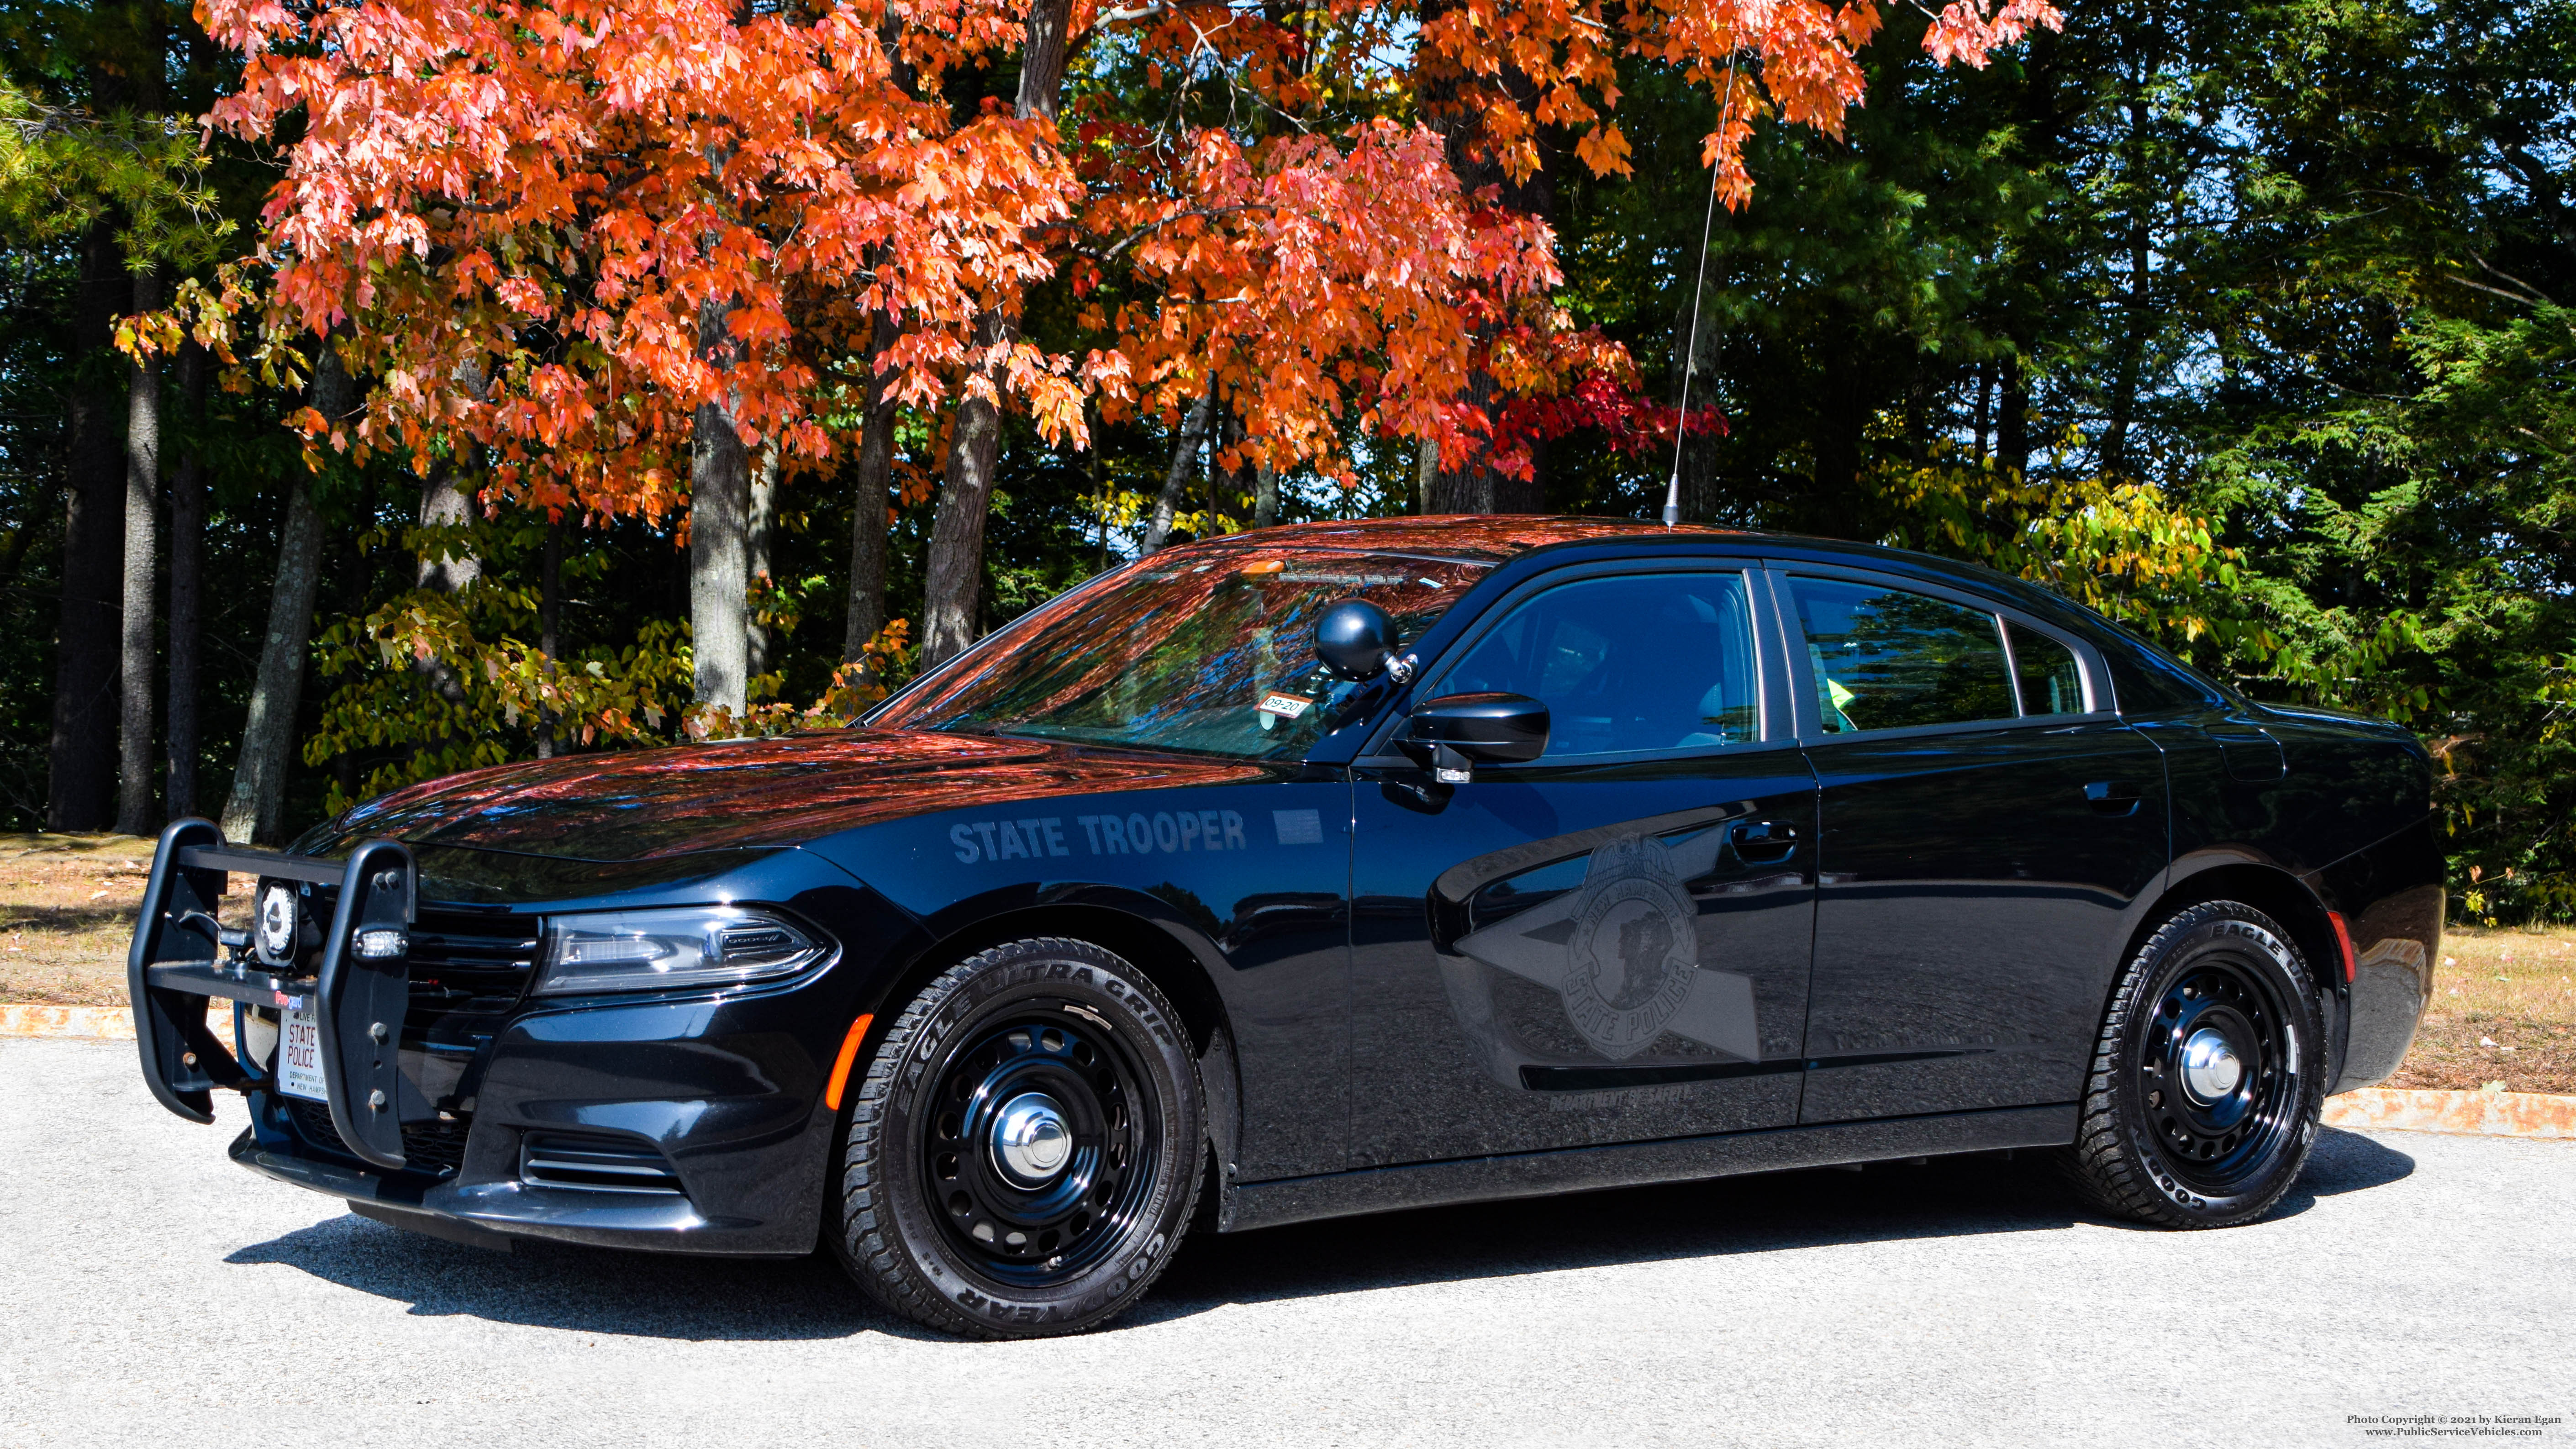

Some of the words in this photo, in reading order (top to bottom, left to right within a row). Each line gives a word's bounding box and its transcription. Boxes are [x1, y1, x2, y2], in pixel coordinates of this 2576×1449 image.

[1264, 698, 1300, 711] 09-20
[950, 817, 1069, 864] STATE
[1077, 810, 1246, 855] TROOPER
[1586, 894, 1611, 925] NEW
[1615, 884, 1679, 923] HAMPSHIRE
[2210, 923, 2284, 957] EAGLE
[1565, 972, 1620, 1041] STATE
[1626, 964, 1695, 1041] POLICE
[300, 1012, 310, 1022] LIVE
[289, 1024, 316, 1046] STATE
[896, 990, 974, 1117] EAGLE
[980, 963, 1094, 996] ULTRA
[1104, 979, 1175, 1048] GRIP
[287, 1045, 315, 1068] POLICE
[290, 1071, 317, 1083] DEPARTMENT
[297, 1083, 307, 1091] NEW
[1549, 1091, 1625, 1112] DEPARTMENT
[956, 1233, 1165, 1323] GOODYEAR
